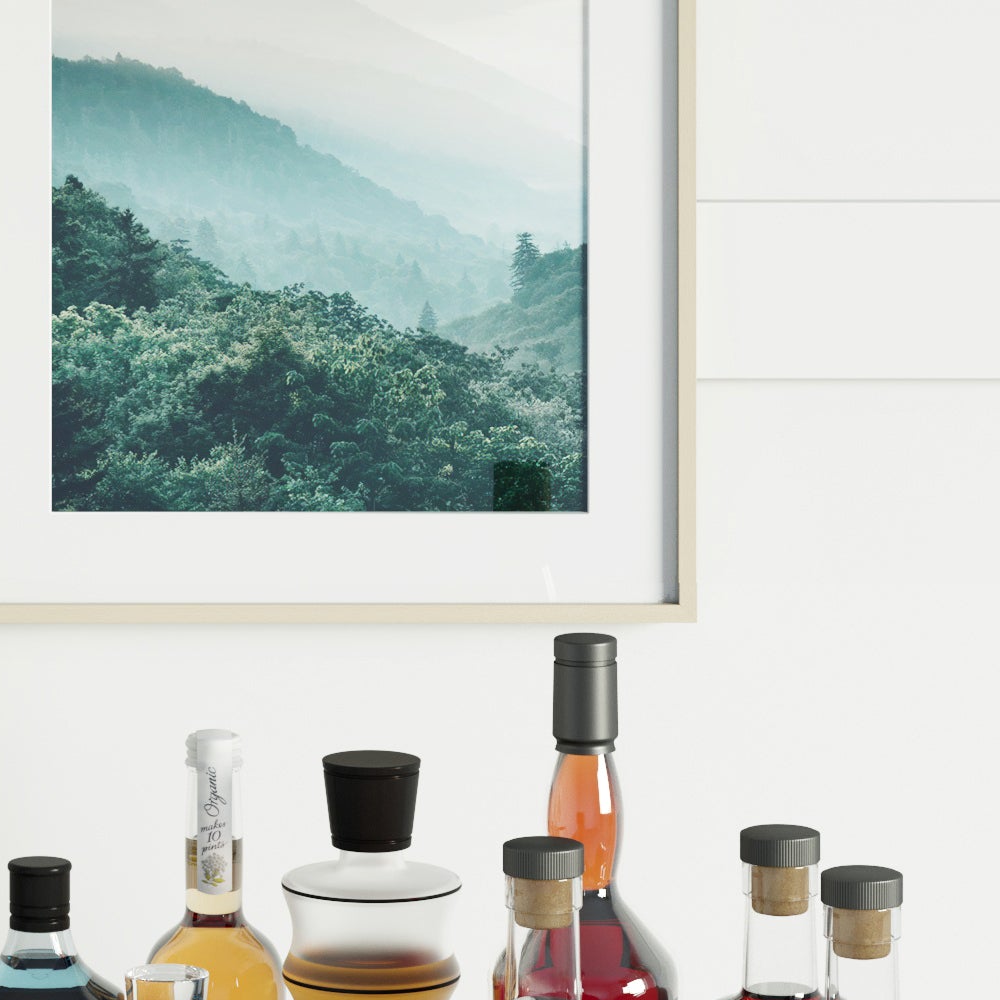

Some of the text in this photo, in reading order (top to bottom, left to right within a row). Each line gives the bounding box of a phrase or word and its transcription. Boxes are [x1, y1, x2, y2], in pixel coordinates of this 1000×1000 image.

[204, 767, 227, 817] Organic
[201, 820, 226, 833] makes
[207, 830, 221, 843] 10
[201, 842, 225, 856] pints
